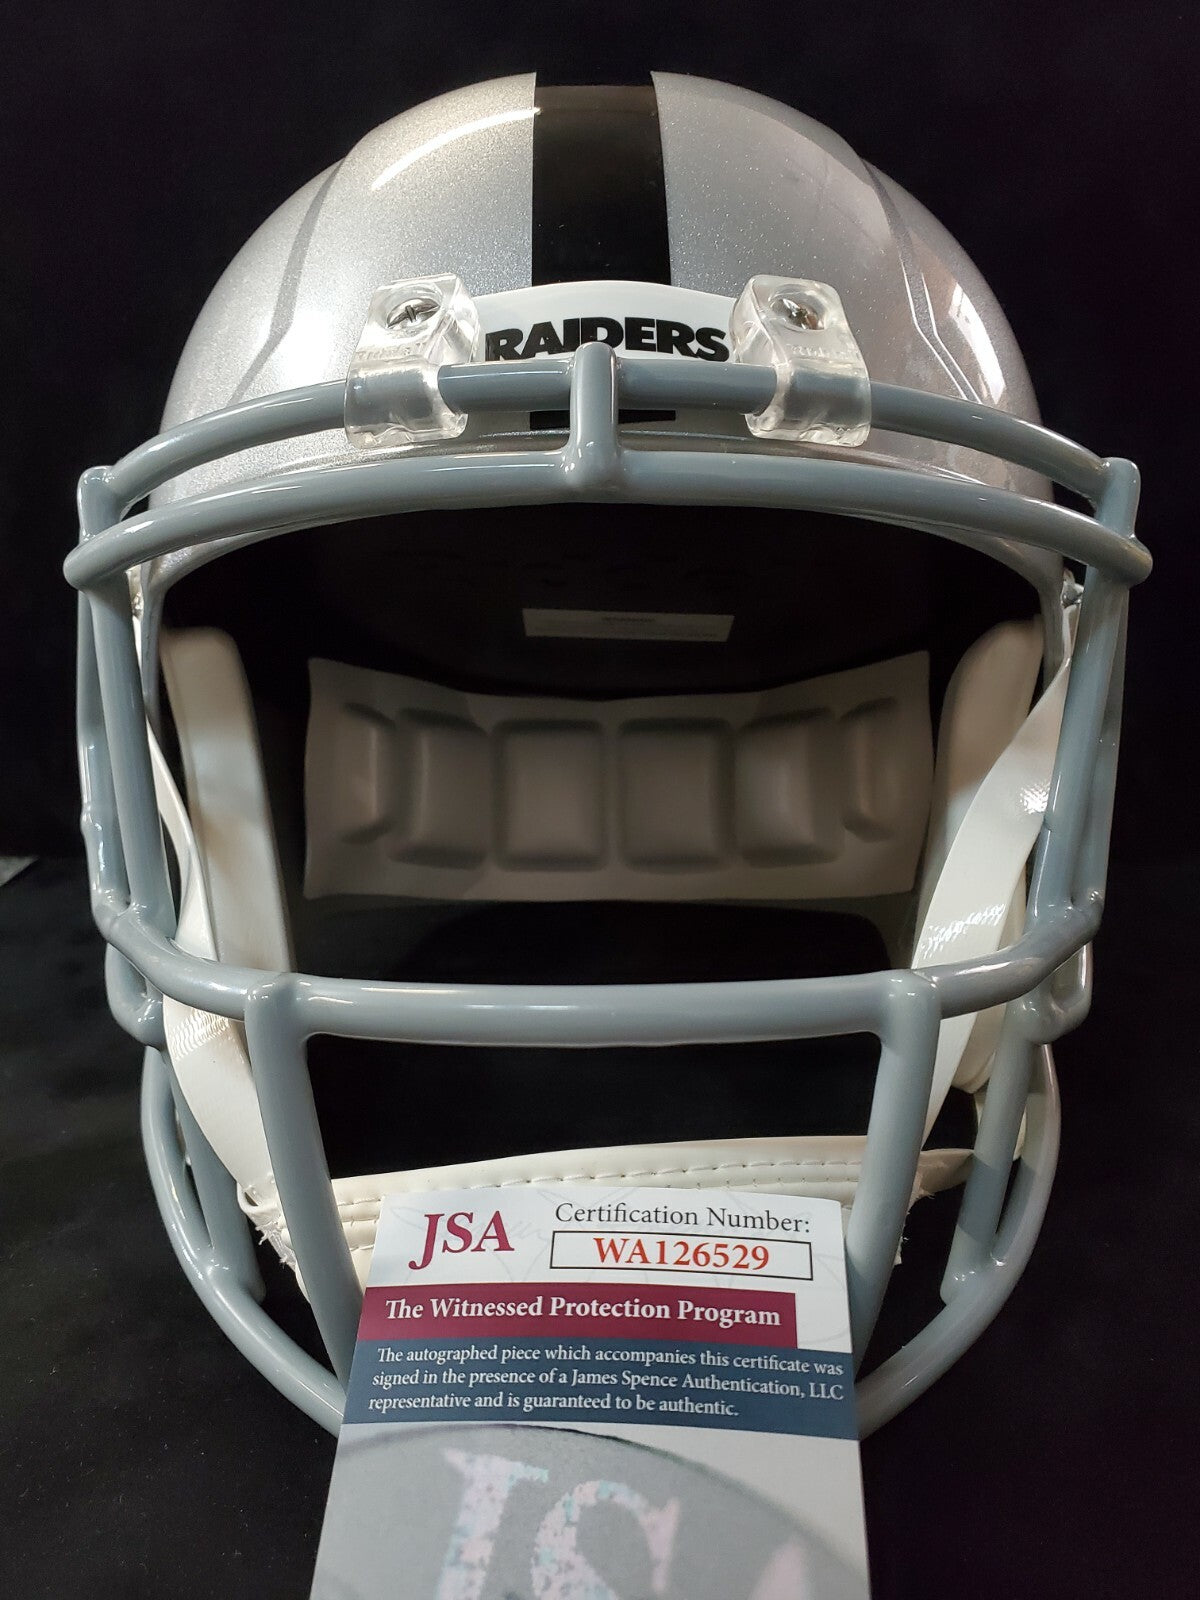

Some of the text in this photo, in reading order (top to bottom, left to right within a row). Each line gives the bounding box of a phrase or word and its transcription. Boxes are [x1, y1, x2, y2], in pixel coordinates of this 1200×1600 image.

[485, 316, 730, 362] RAIDERS
[555, 1203, 811, 1233] Certification Number:
[408, 1210, 515, 1270] JSA
[593, 1237, 770, 1270] WA126529
[386, 1296, 781, 1328] The Witnessed Protection Program
[377, 1344, 844, 1376] The autographed piece which accompanies this certificate was
[372, 1367, 844, 1400] signed in the presence of a James Spence Authentication, LLC
[368, 1391, 739, 1416] representative and is guaranteed to be authentic.
